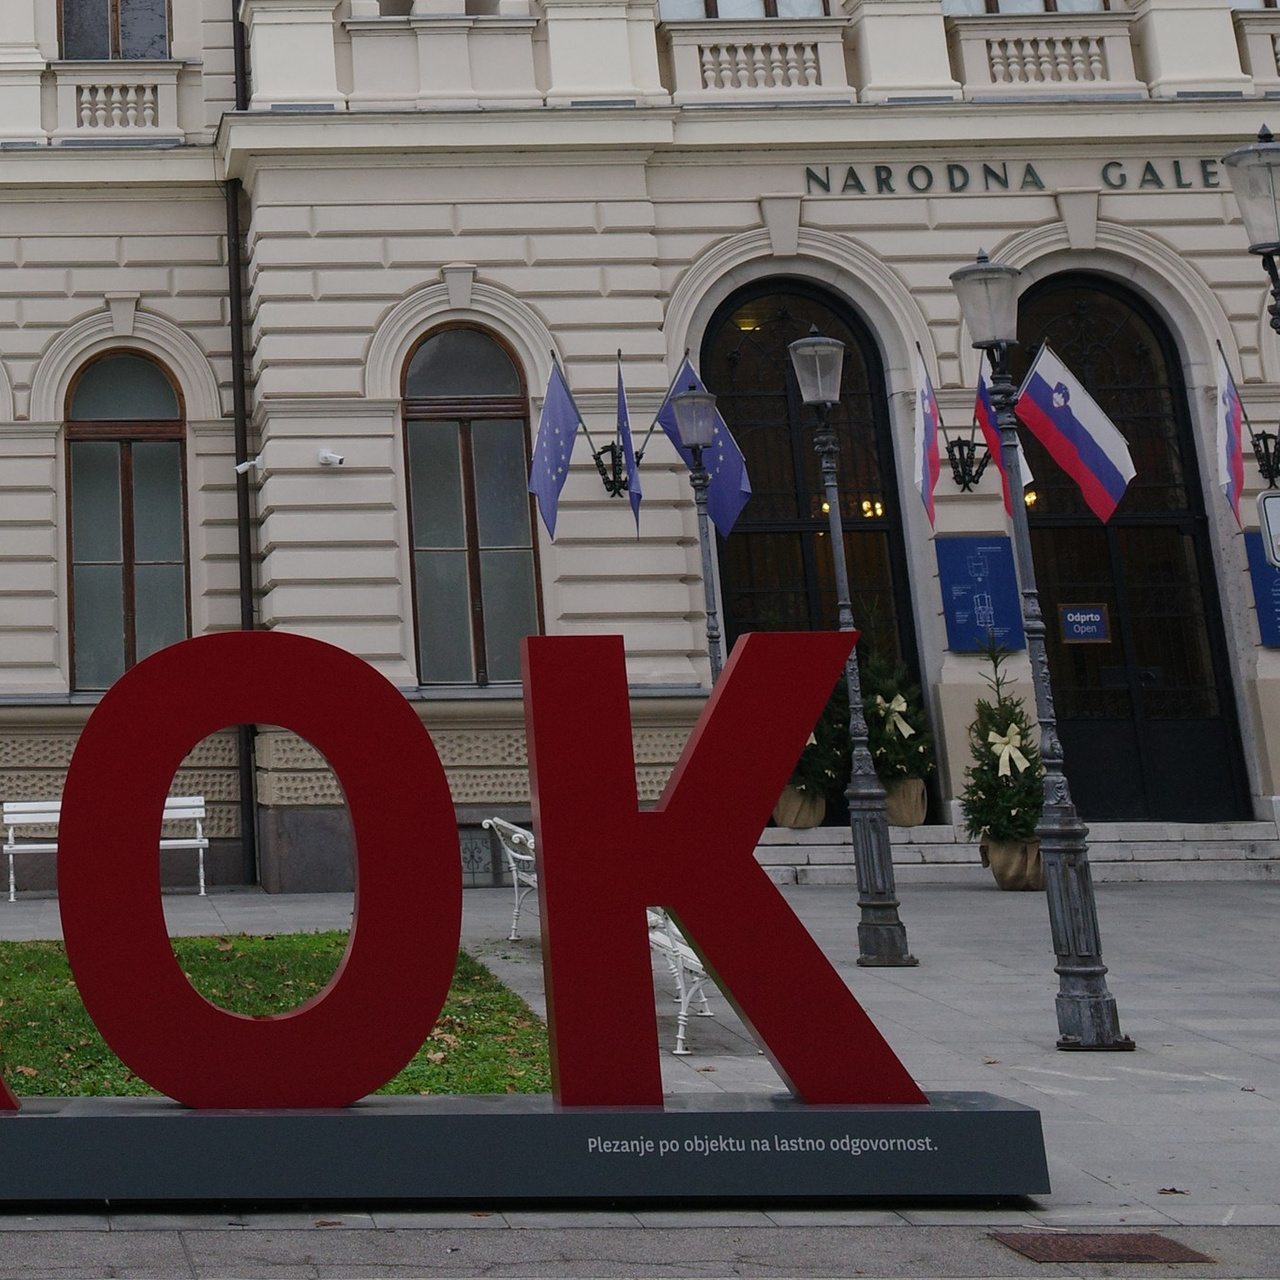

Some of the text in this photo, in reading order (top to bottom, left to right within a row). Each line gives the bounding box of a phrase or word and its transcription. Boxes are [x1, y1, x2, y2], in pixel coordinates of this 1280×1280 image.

[806, 159, 1220, 194] NARODNA GALE
[1067, 612, 1101, 624] Odprto
[1073, 624, 1098, 635] Open
[587, 1134, 939, 1157] Plezanje po objektu na lastno odgovornost.
